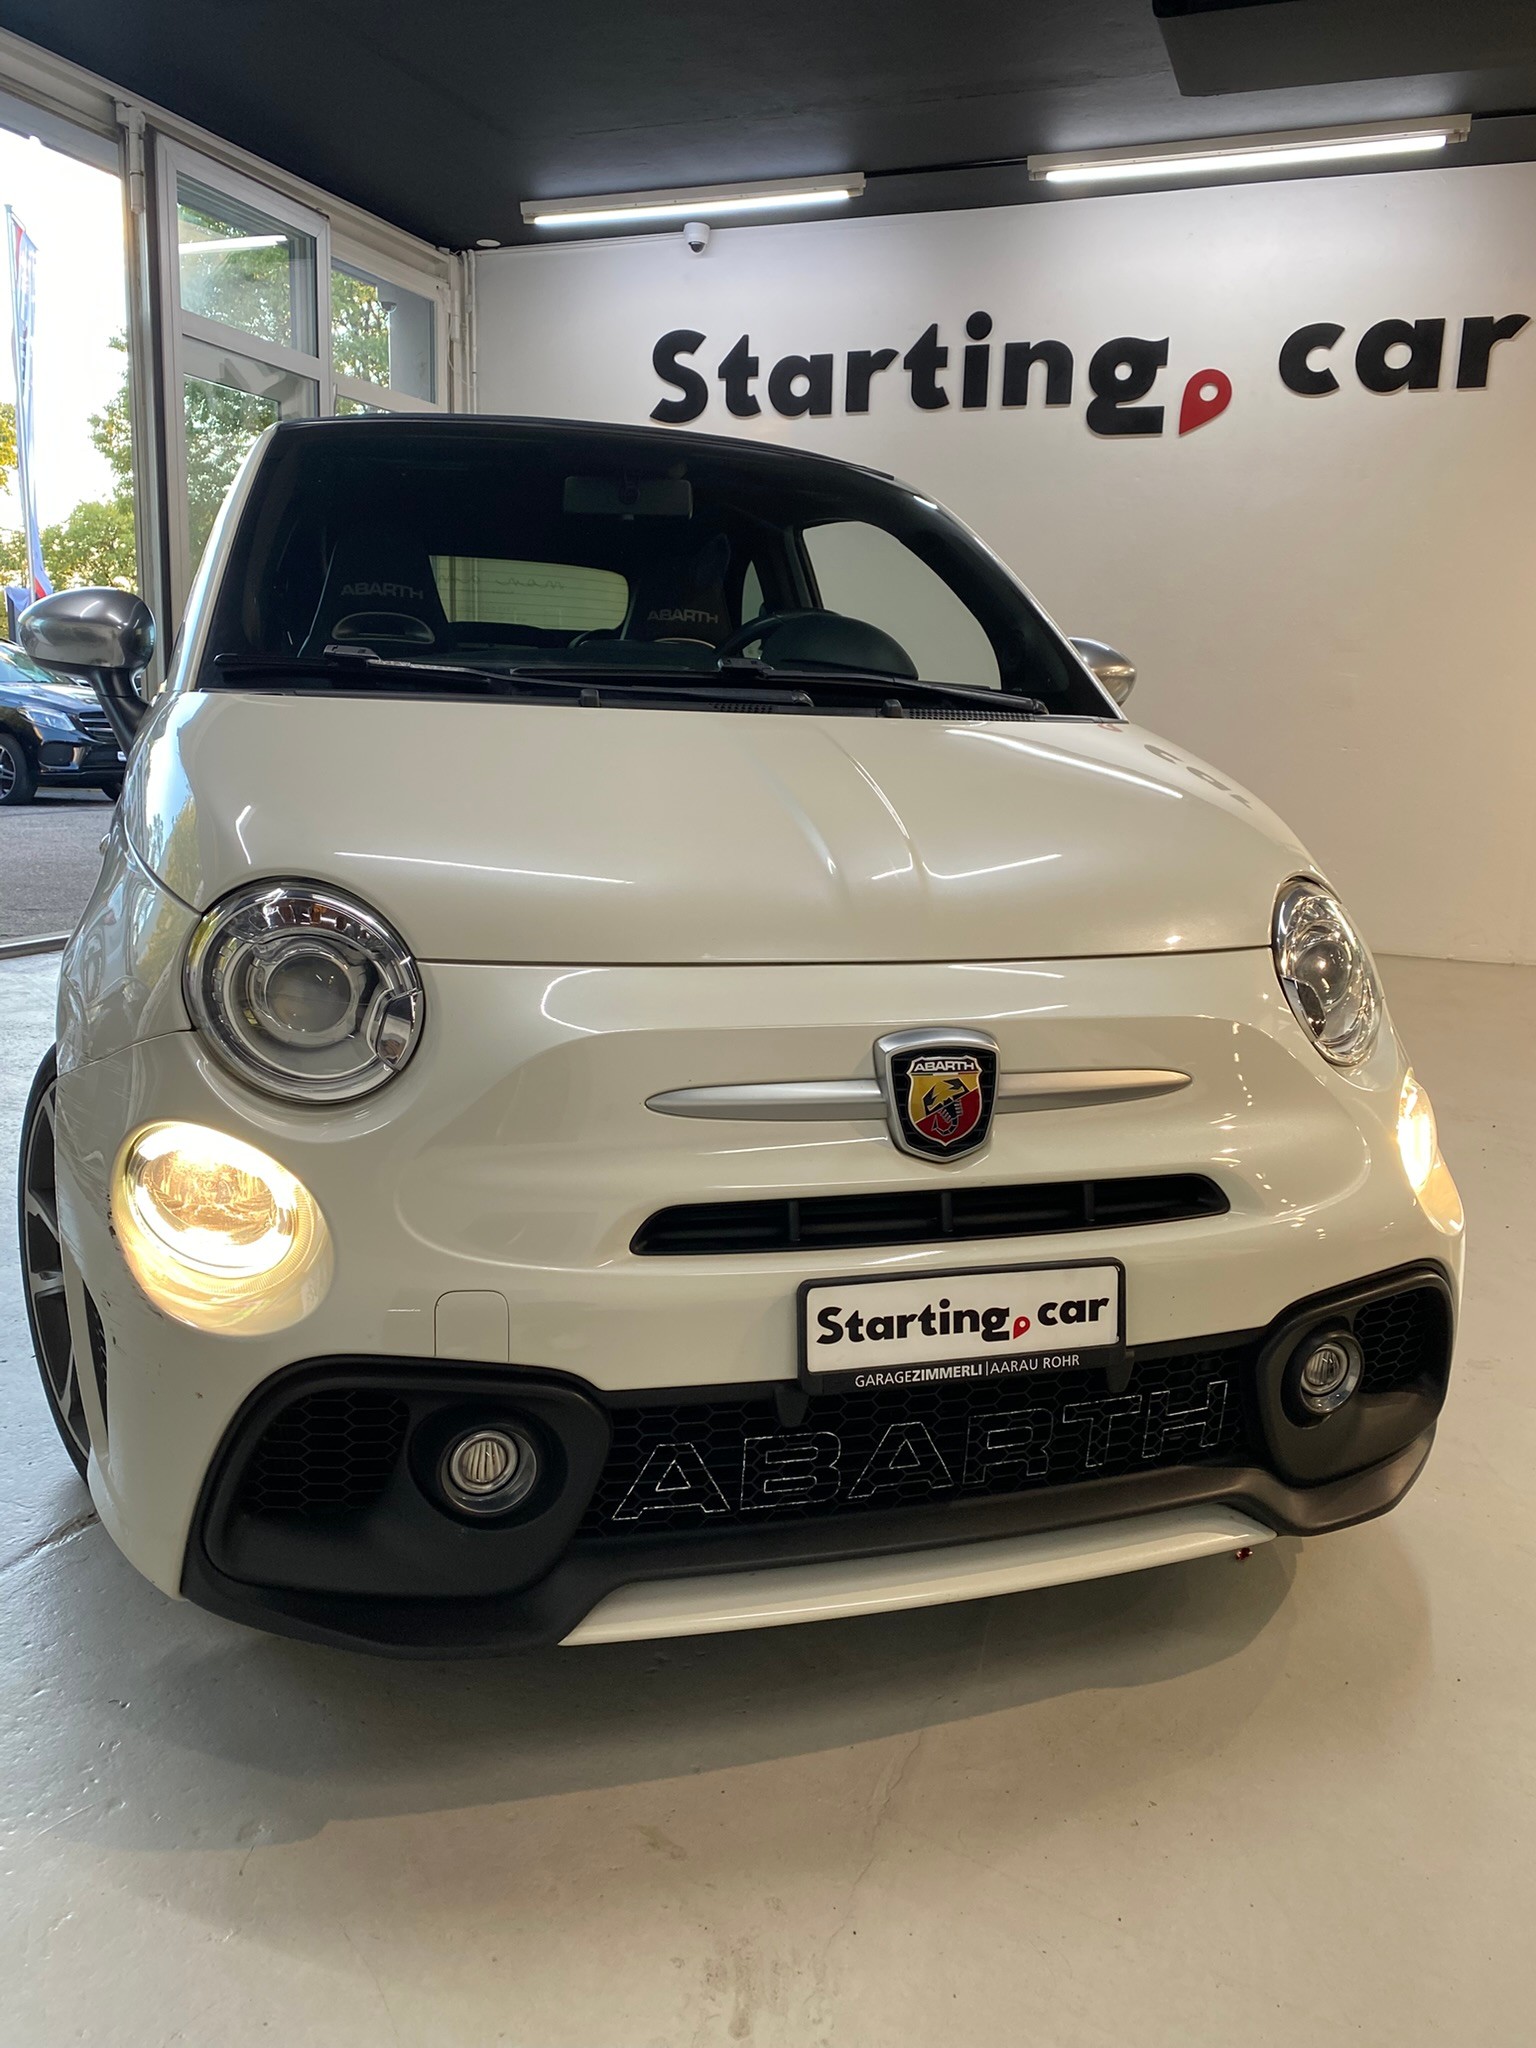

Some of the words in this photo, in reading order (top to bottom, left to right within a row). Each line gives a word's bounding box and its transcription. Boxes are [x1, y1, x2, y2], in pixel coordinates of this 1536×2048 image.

[649, 311, 1169, 435] Starting
[1278, 313, 1532, 395] car
[341, 581, 424, 600] ABARTH
[647, 608, 719, 624] ABARTH
[914, 1060, 975, 1072] ABARTH
[816, 1298, 1010, 1345] Starting
[1037, 1297, 1110, 1327] car
[1043, 1354, 1080, 1369] ROHR
[612, 1380, 1228, 1520] ABARTH
